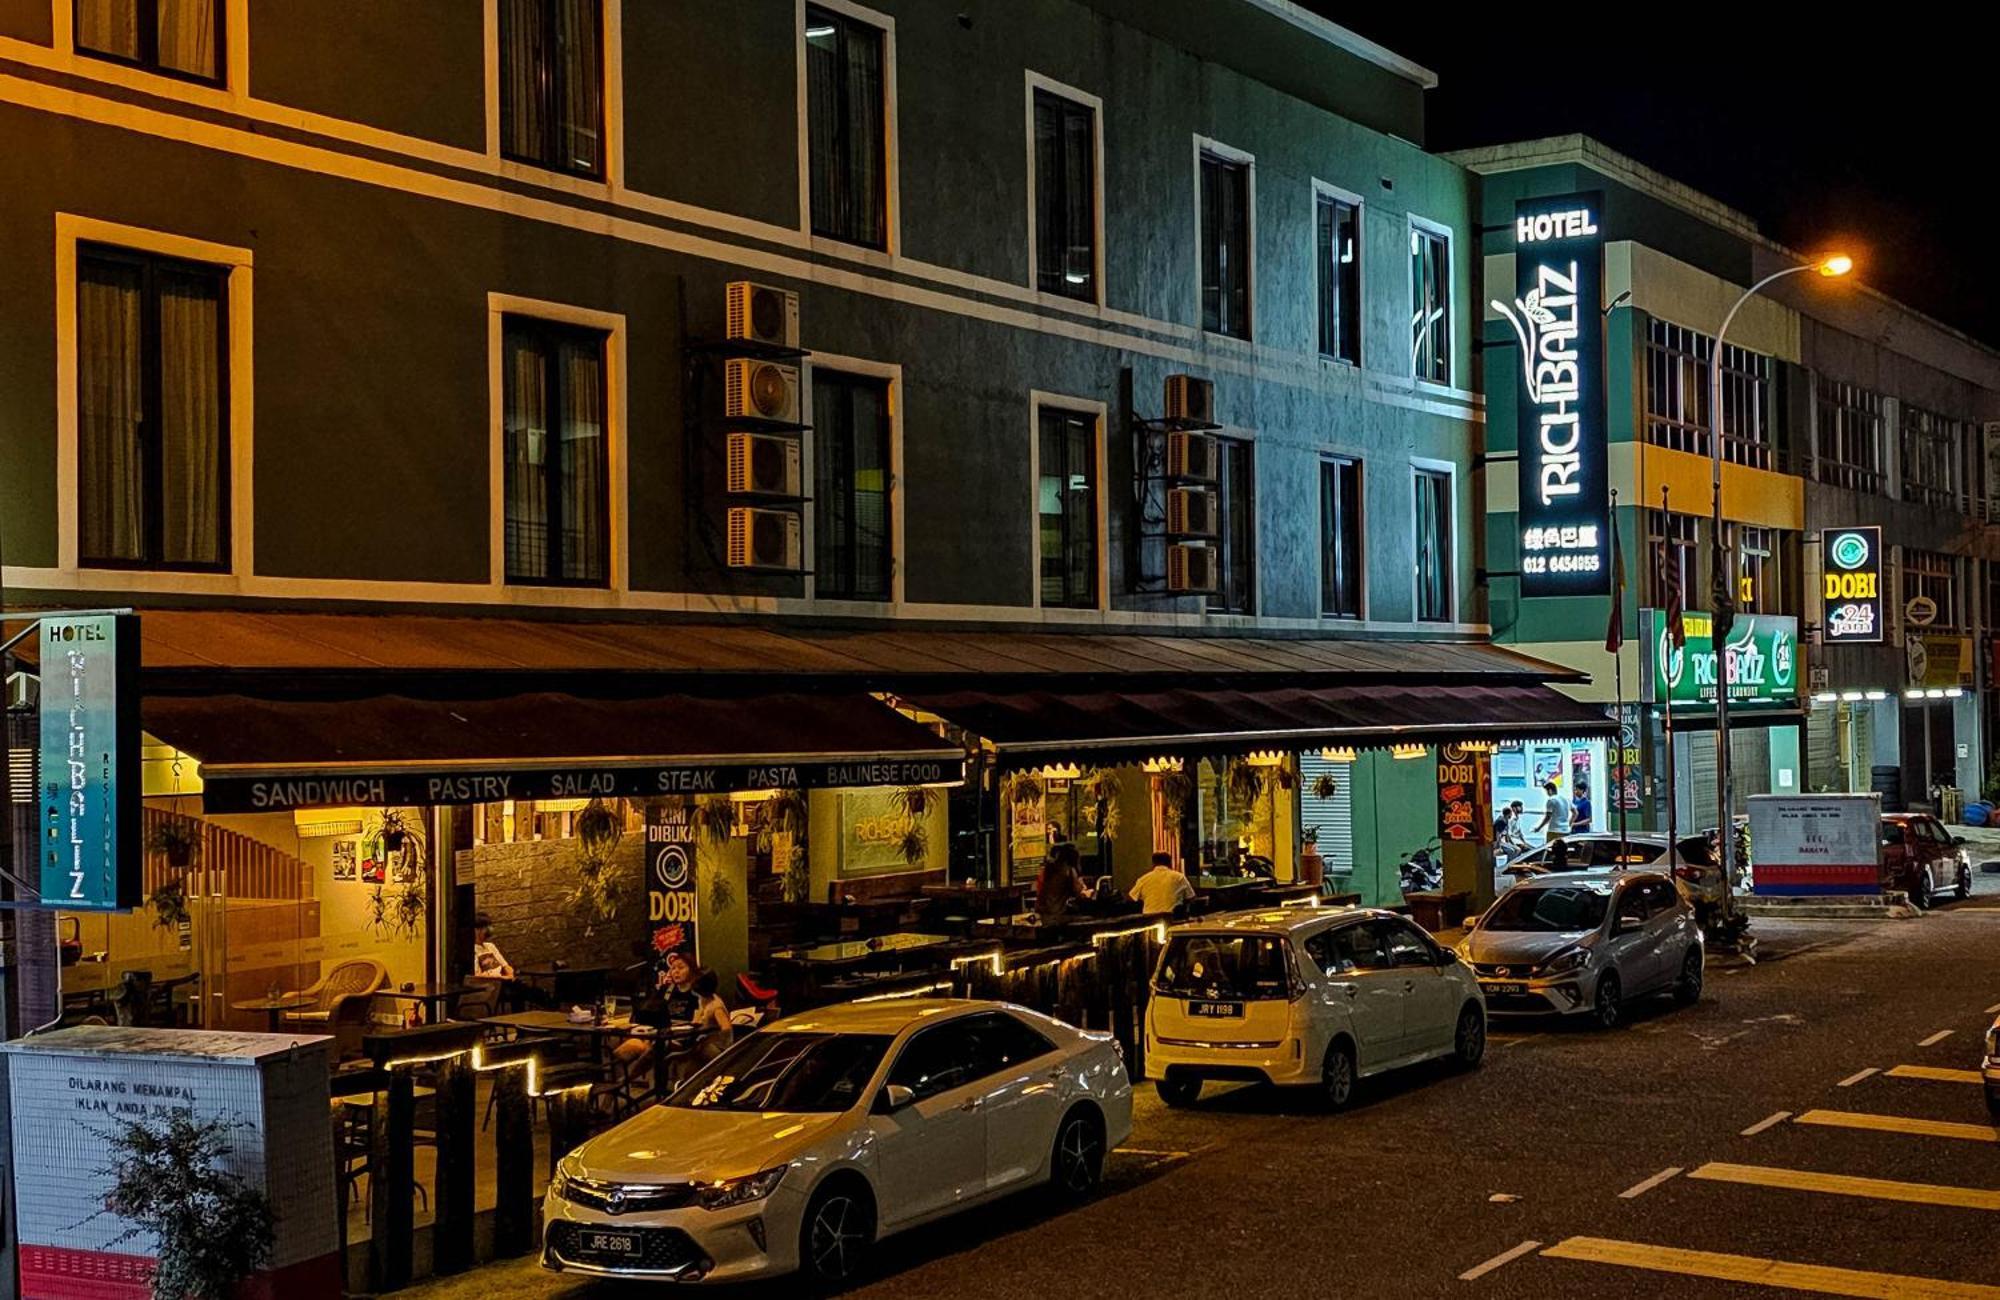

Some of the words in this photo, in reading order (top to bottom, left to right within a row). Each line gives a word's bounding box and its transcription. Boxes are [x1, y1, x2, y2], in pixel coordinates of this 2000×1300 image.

[1517, 209, 1597, 243] HOTEL
[1536, 260, 1580, 506] RICHBALIZ
[1523, 556, 1546, 573] 012
[1825, 573, 1877, 599] DOBI
[1843, 604, 1875, 621] 24
[50, 624, 105, 642] HOTEL
[1831, 619, 1872, 636] jam
[1692, 650, 1765, 685] RICBALIZ
[551, 773, 615, 795] SALAD
[658, 770, 716, 791] STEAK
[748, 767, 799, 786] PASTA
[828, 764, 899, 784] BALINESE
[902, 763, 941, 782] FOOD
[1439, 765, 1474, 783] DOBI
[252, 779, 385, 807] SANDWICH
[428, 776, 512, 800] PASTRY
[660, 807, 687, 825] KINI
[649, 891, 696, 922] DOBI
[68, 1077, 127, 1094] DILARANG
[133, 1083, 197, 1101] MENAMPAL
[75, 1097, 107, 1111] IKLAN
[116, 1103, 148, 1116] ANDA
[589, 1235, 609, 1249] JRE
